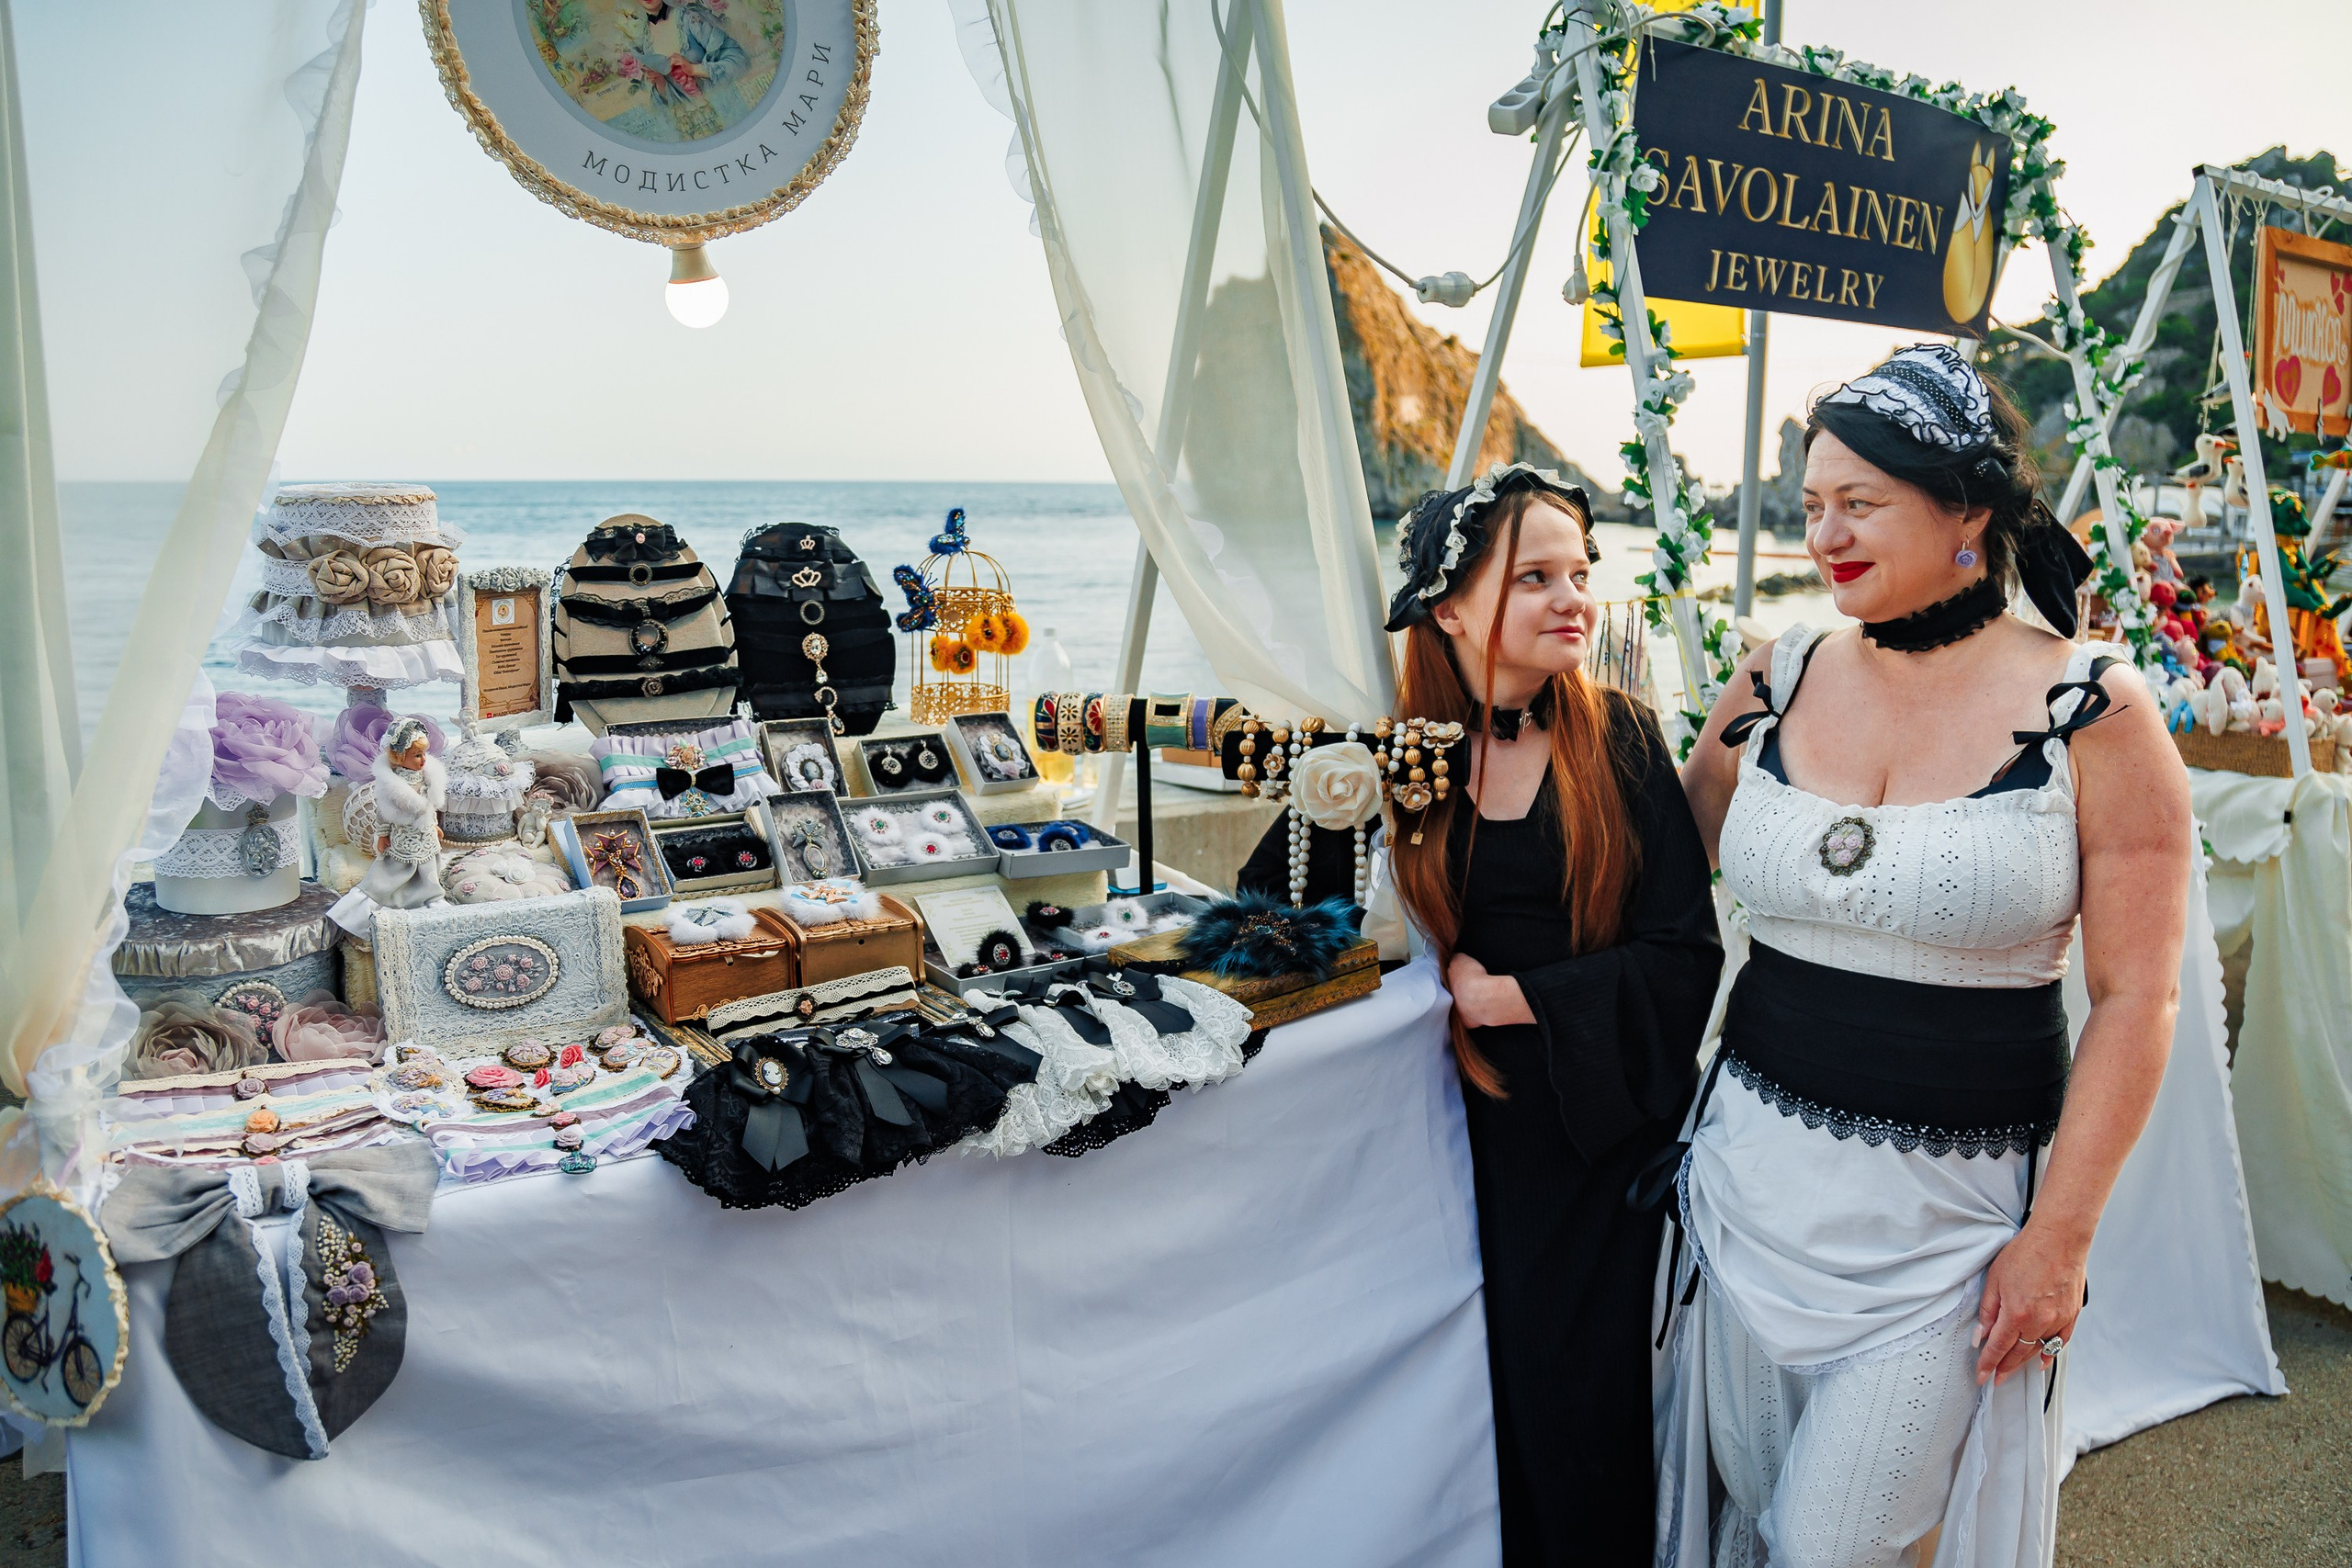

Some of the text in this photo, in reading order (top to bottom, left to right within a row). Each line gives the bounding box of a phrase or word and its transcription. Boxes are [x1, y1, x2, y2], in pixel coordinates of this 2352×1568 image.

[582, 42, 831, 193] МОДИСТКА МАРИ
[1737, 77, 1895, 163] ARINA
[1644, 147, 1945, 255] SAVOLAINEN
[1705, 249, 1885, 310] JEWELRY
